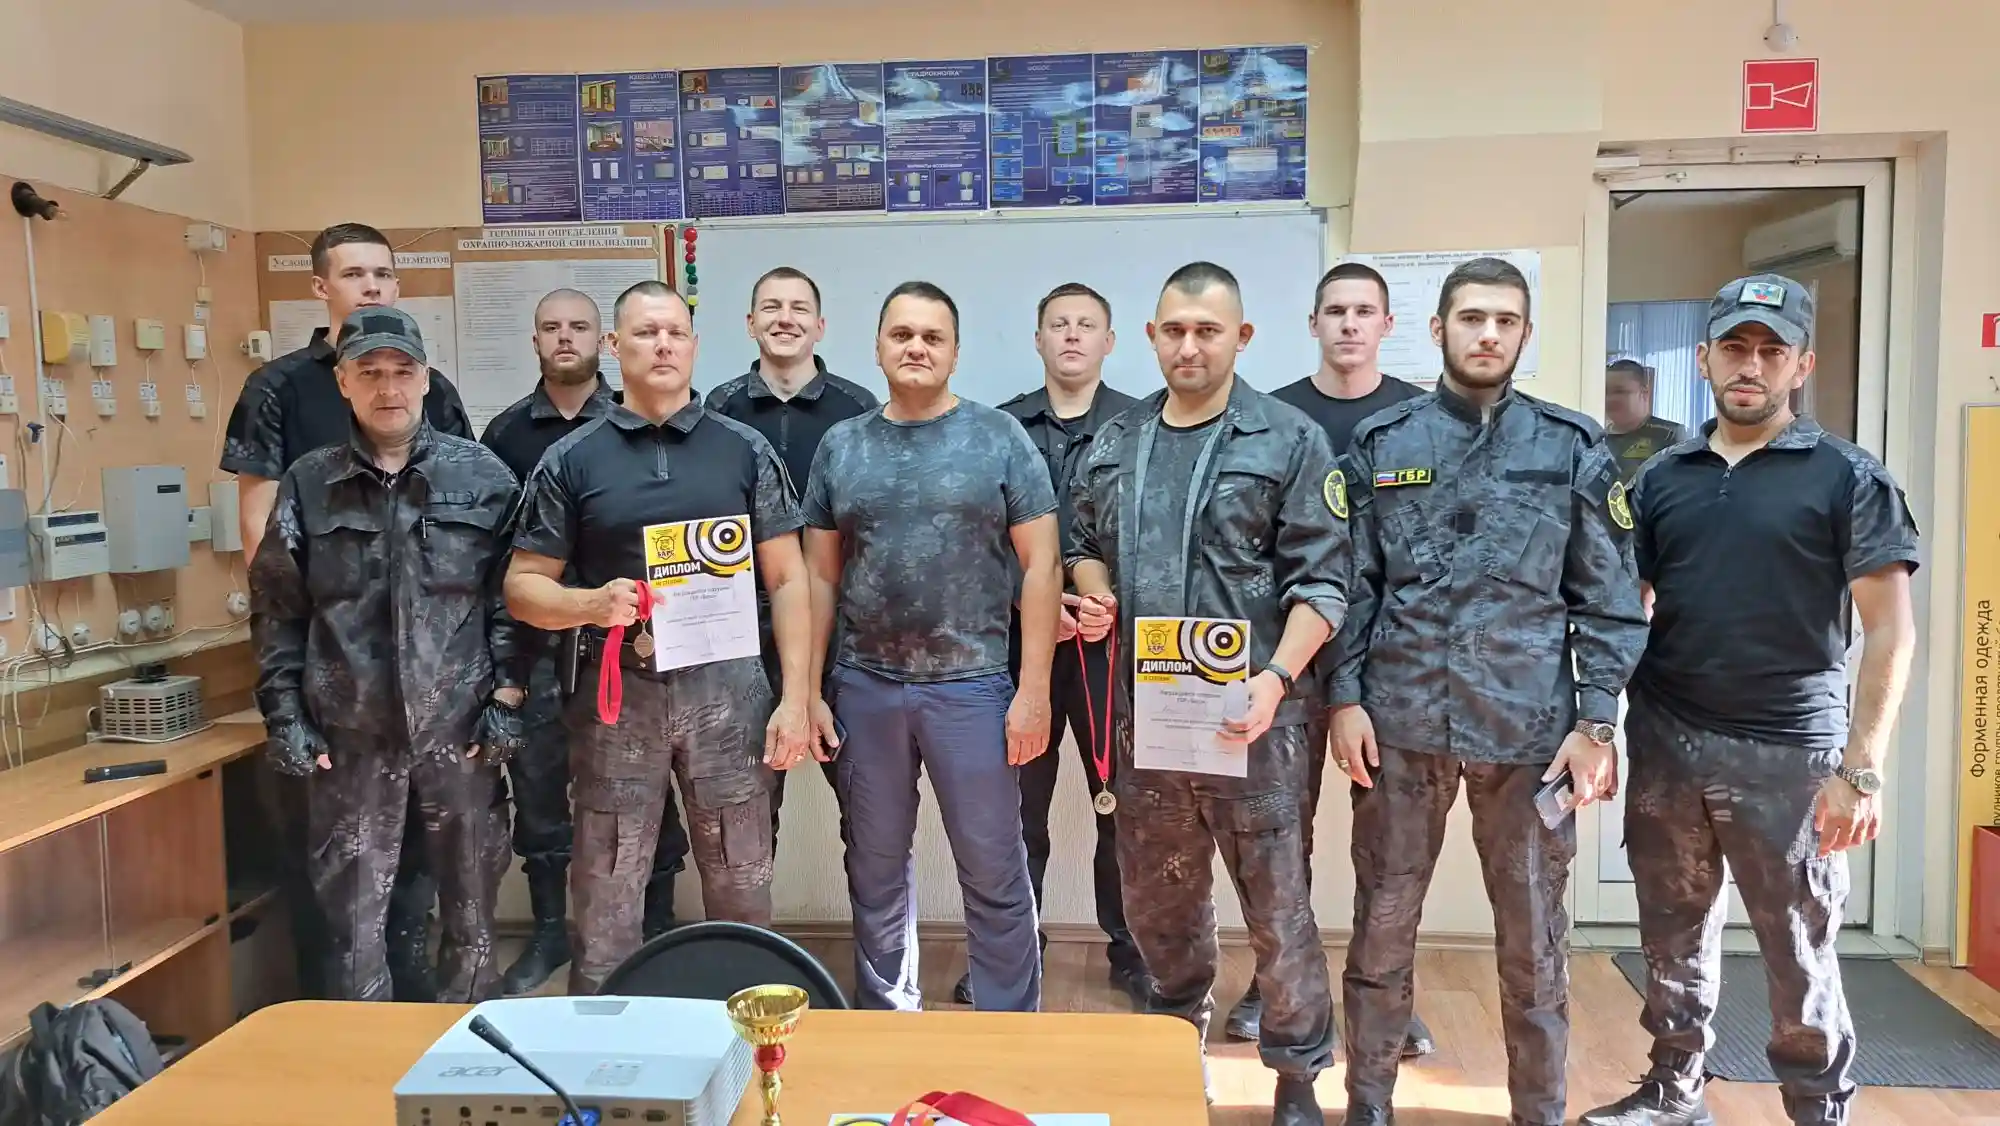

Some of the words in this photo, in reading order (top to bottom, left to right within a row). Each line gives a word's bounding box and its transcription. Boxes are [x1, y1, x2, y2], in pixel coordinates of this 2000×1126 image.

[1399, 470, 1427, 482] ГБР
[653, 562, 701, 579] ДИПЛОМ
[1976, 599, 1993, 669] одежда
[1141, 660, 1192, 673] ДИПЛОМ
[1970, 675, 1990, 778] Форменная
[438, 1065, 518, 1078] acer
